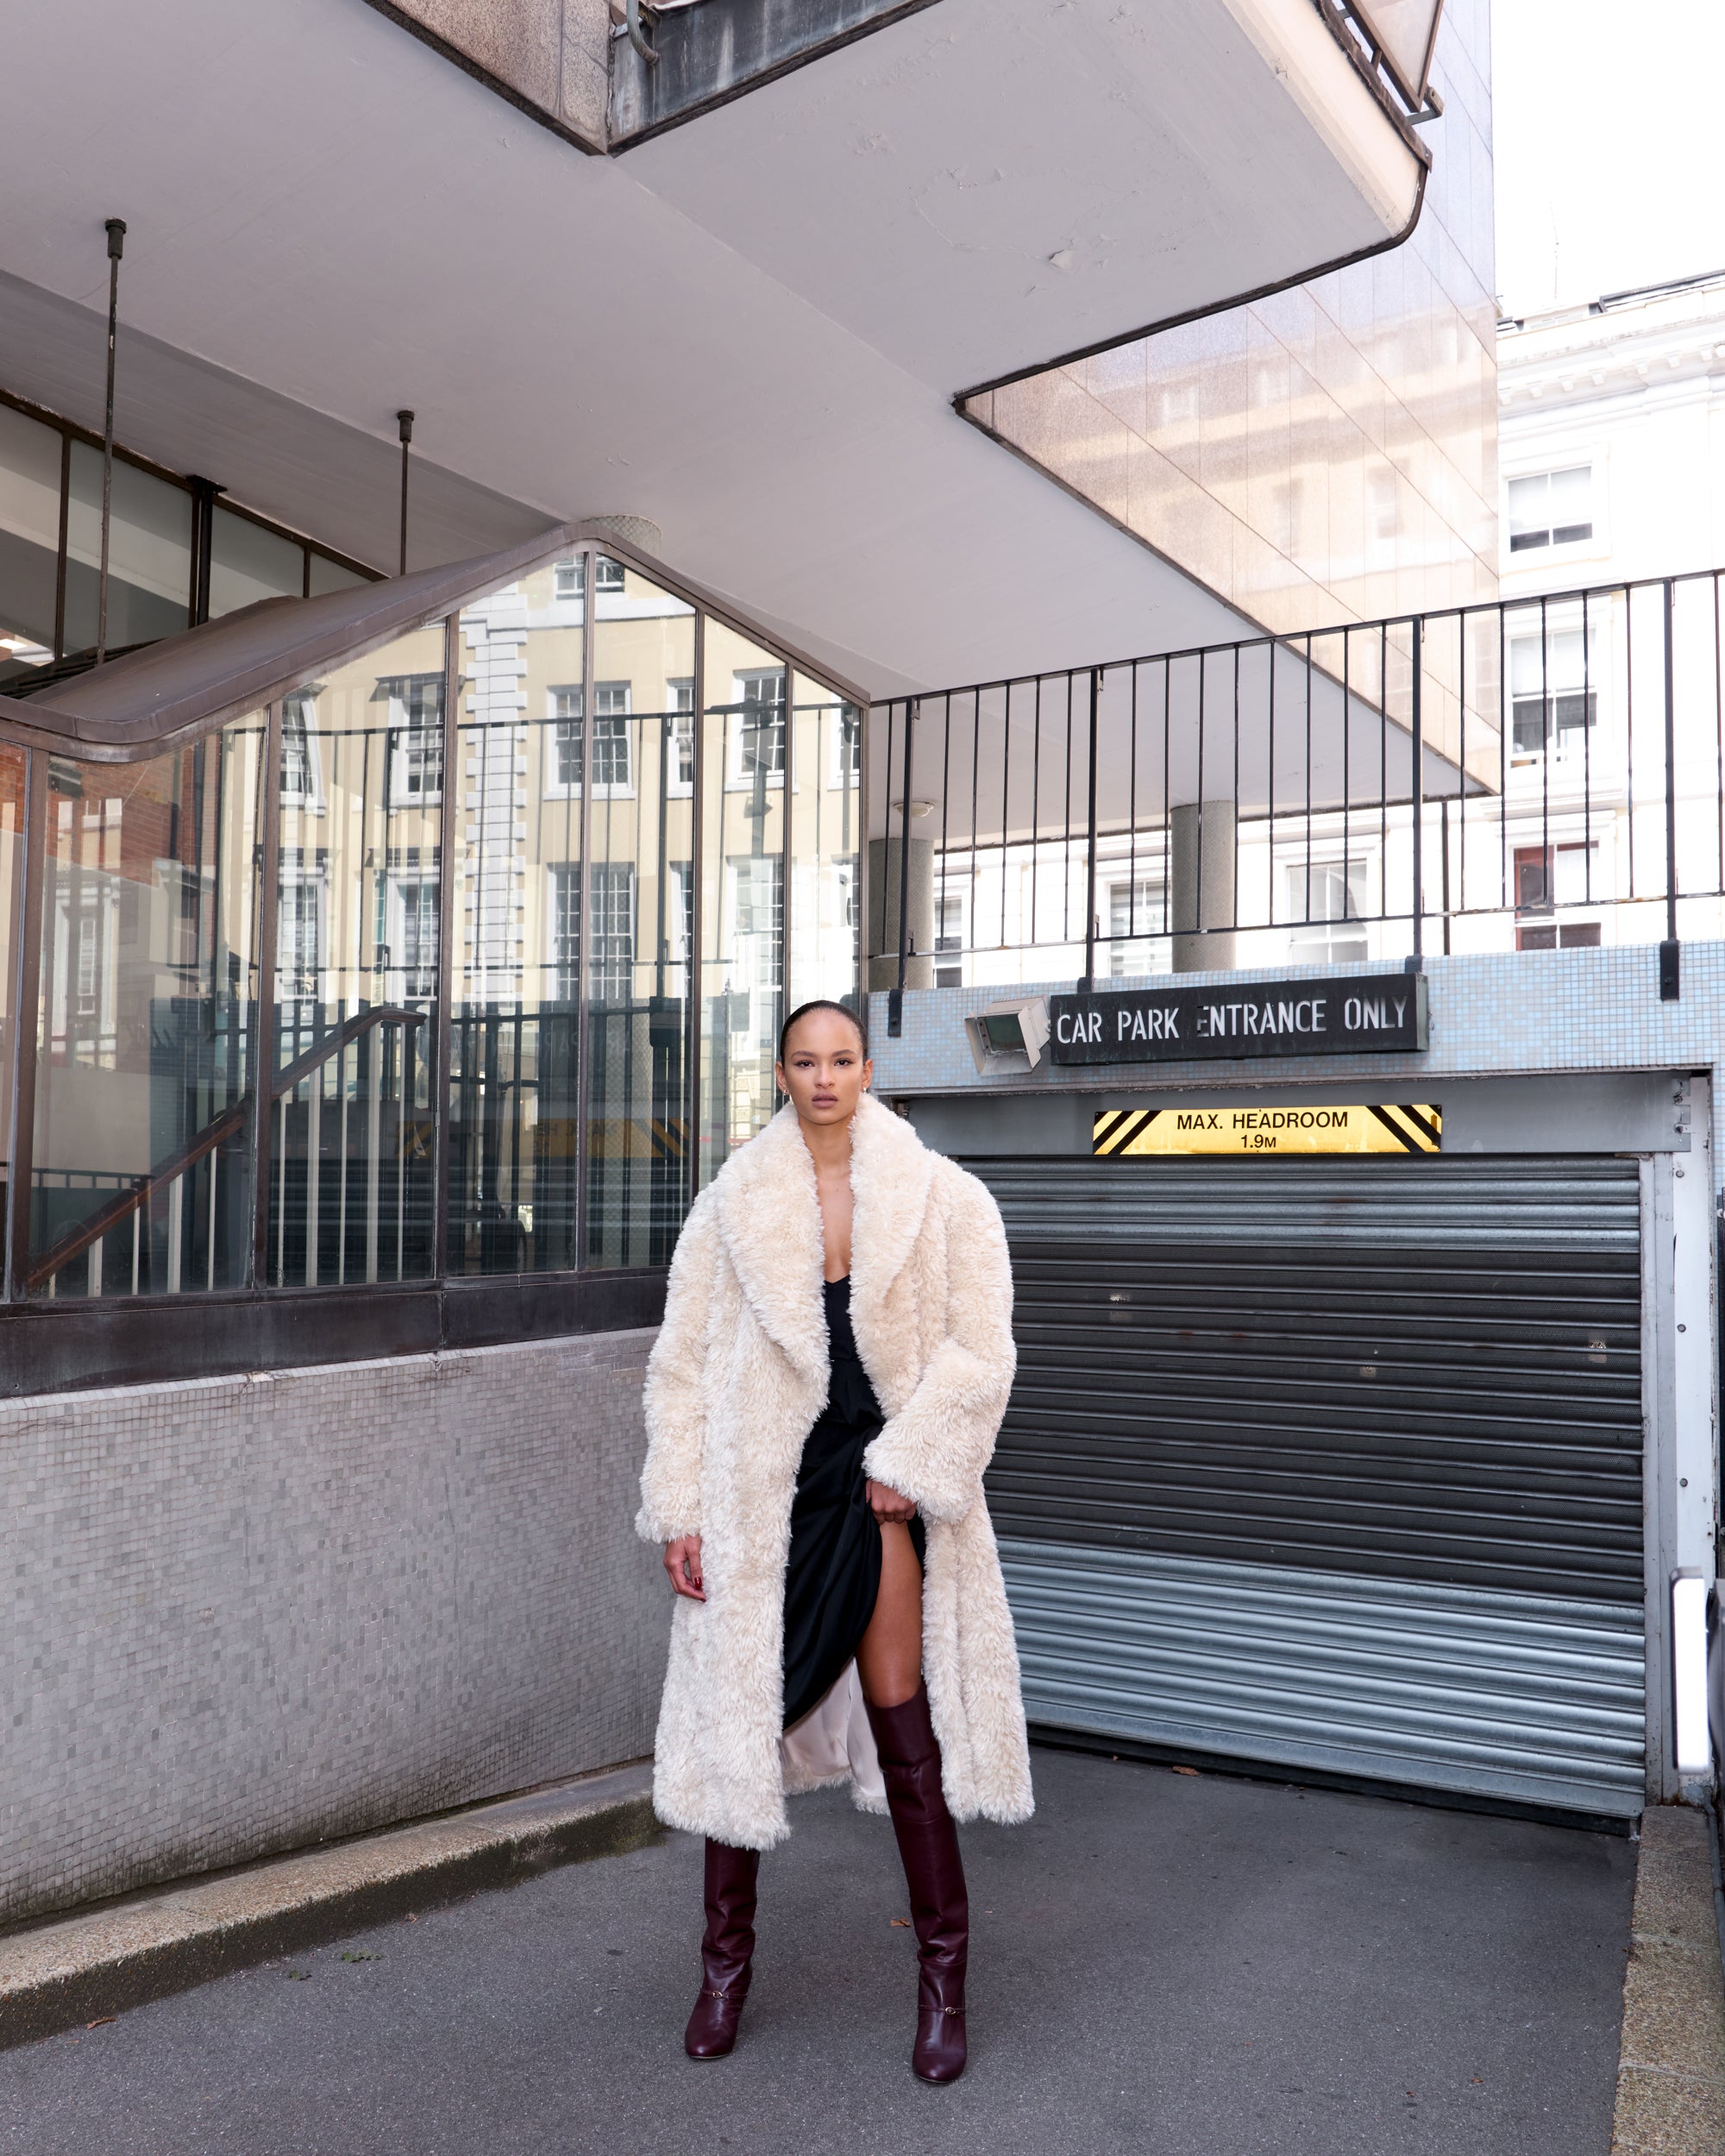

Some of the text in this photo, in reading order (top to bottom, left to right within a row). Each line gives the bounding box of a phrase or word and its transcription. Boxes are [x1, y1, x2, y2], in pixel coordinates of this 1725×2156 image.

[1057, 1012, 1102, 1044] CAR
[1118, 1007, 1180, 1041] PARK
[1344, 995, 1408, 1031] ONLY
[1176, 1111, 1349, 1130] MAX. HEADROOM
